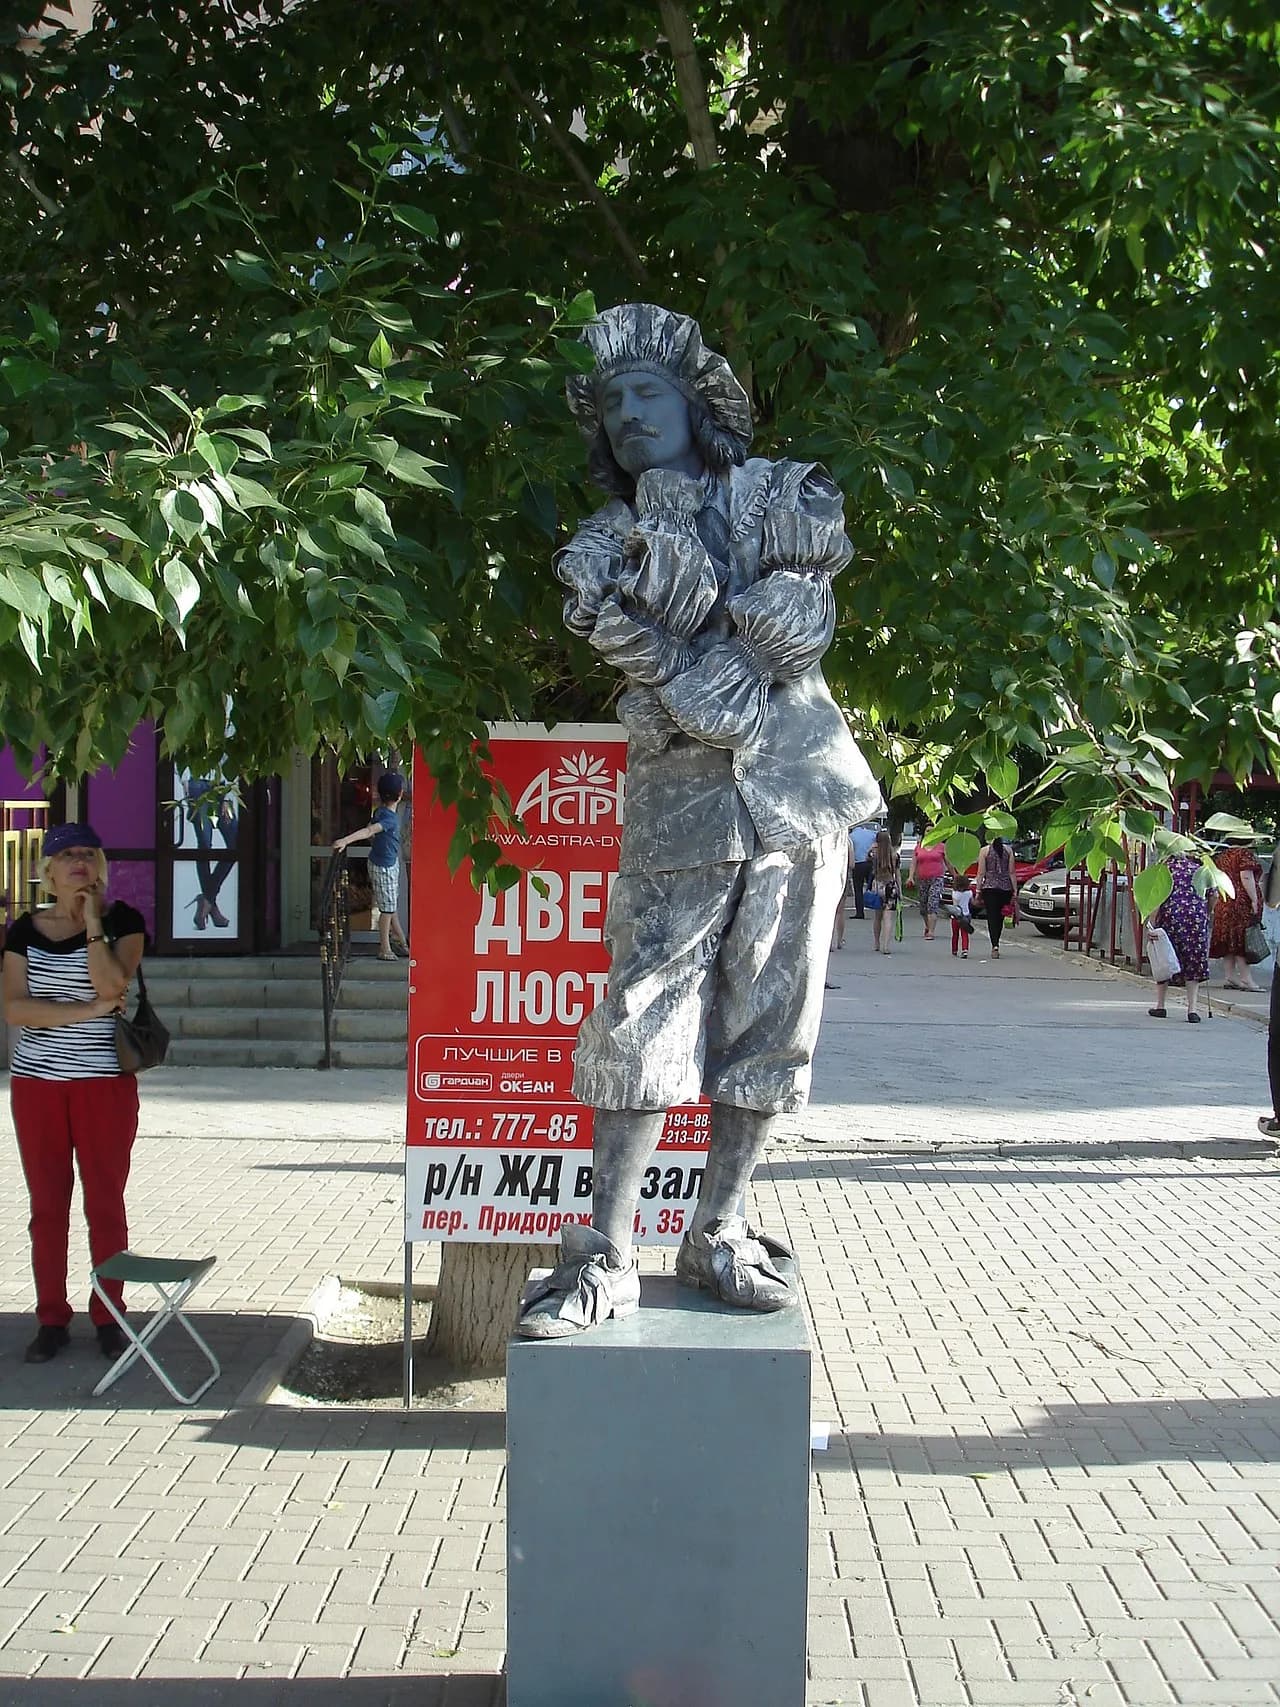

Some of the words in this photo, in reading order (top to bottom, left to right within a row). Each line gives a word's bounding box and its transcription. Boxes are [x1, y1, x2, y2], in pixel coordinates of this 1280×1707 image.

[442, 1047, 539, 1062] ЛУЧШИЕ
[501, 1072, 525, 1080] двери
[500, 1081, 554, 1094] ОКЕАН
[425, 1117, 483, 1140] тел.:
[423, 1153, 483, 1205] р/н
[493, 1154, 563, 1206] ЖД
[573, 1166, 706, 1200] взал
[422, 1210, 468, 1236] пер.
[656, 1208, 685, 1234] 35
